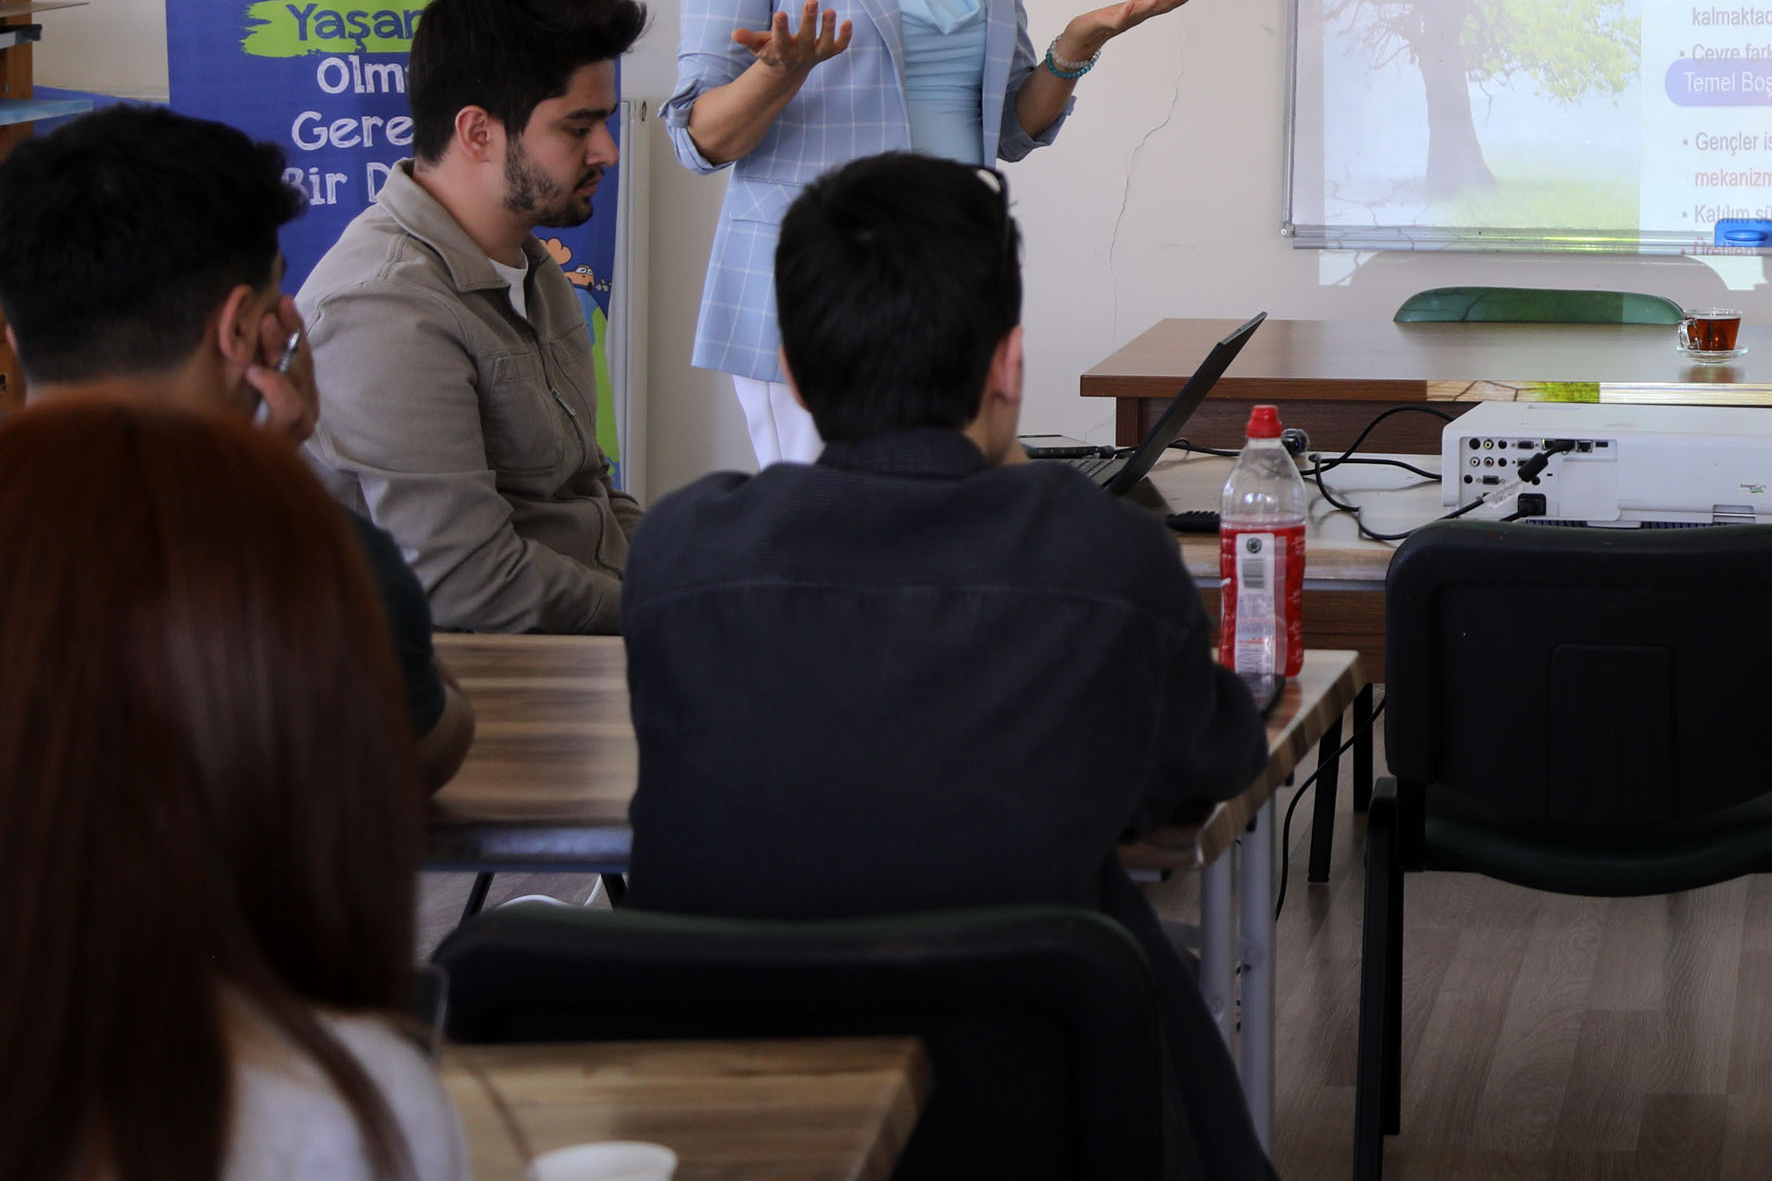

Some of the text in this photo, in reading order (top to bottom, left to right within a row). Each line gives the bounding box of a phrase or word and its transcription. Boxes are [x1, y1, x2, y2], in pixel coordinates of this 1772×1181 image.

[1692, 43, 1740, 67] Çevre
[1684, 72, 1735, 91] Temel
[1696, 131, 1759, 155] Gençler
